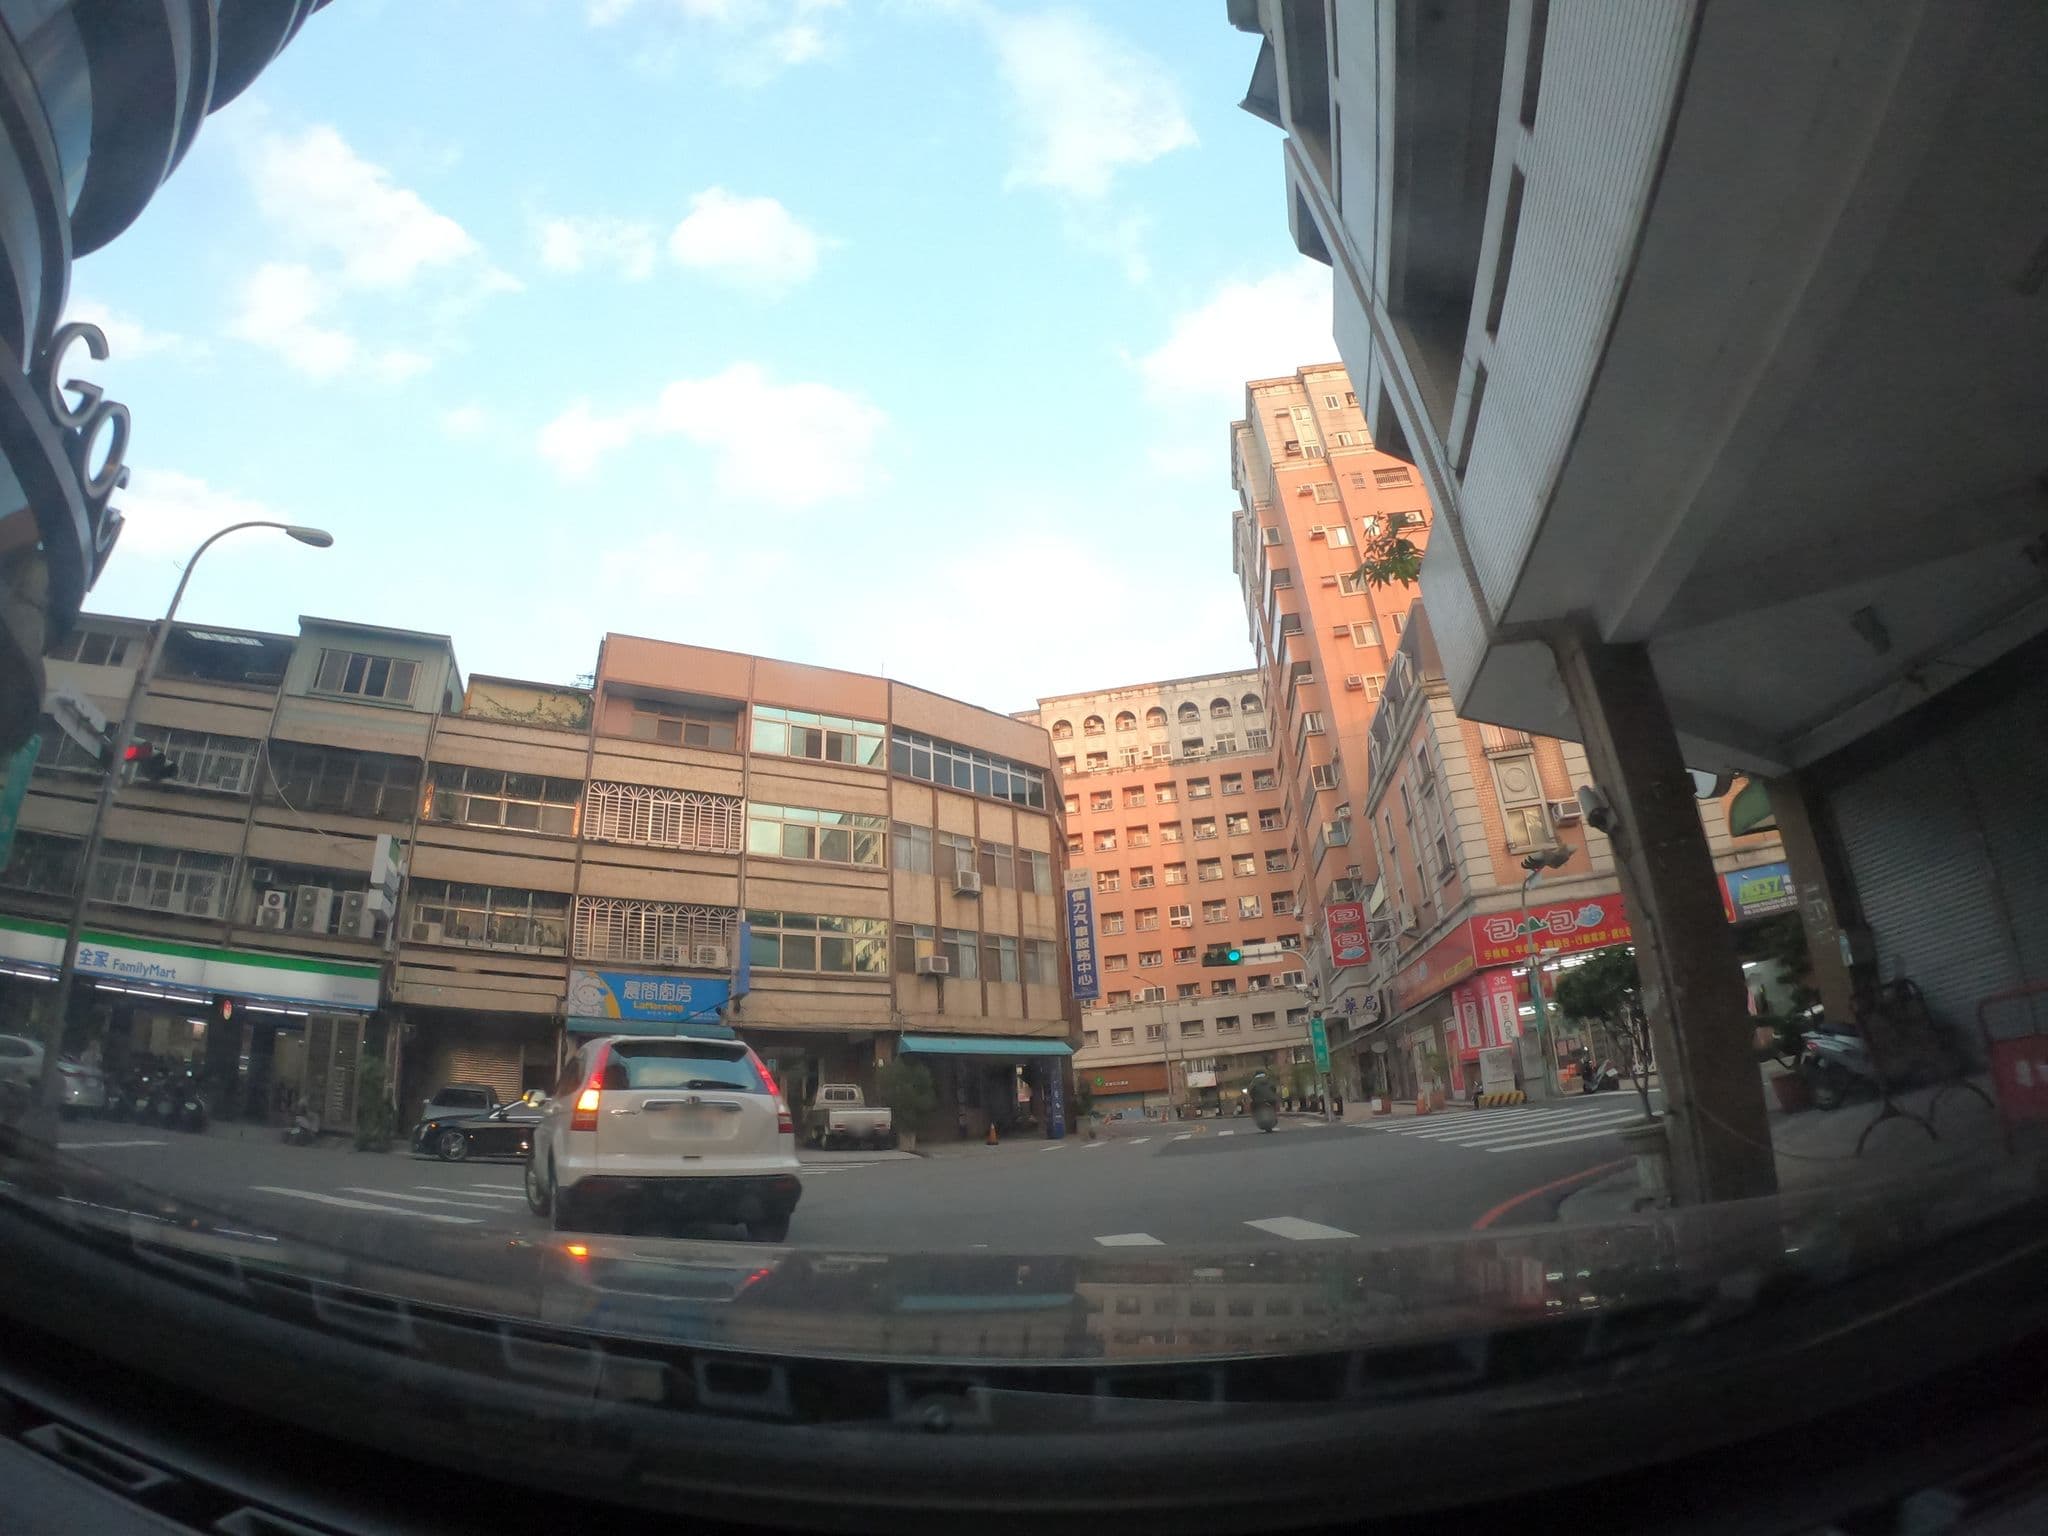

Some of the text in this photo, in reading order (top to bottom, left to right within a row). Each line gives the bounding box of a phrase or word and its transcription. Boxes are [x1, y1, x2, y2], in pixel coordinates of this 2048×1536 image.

[79, 948, 176, 979] 全家 FamilyMart
[1494, 976, 1507, 985] 3C
